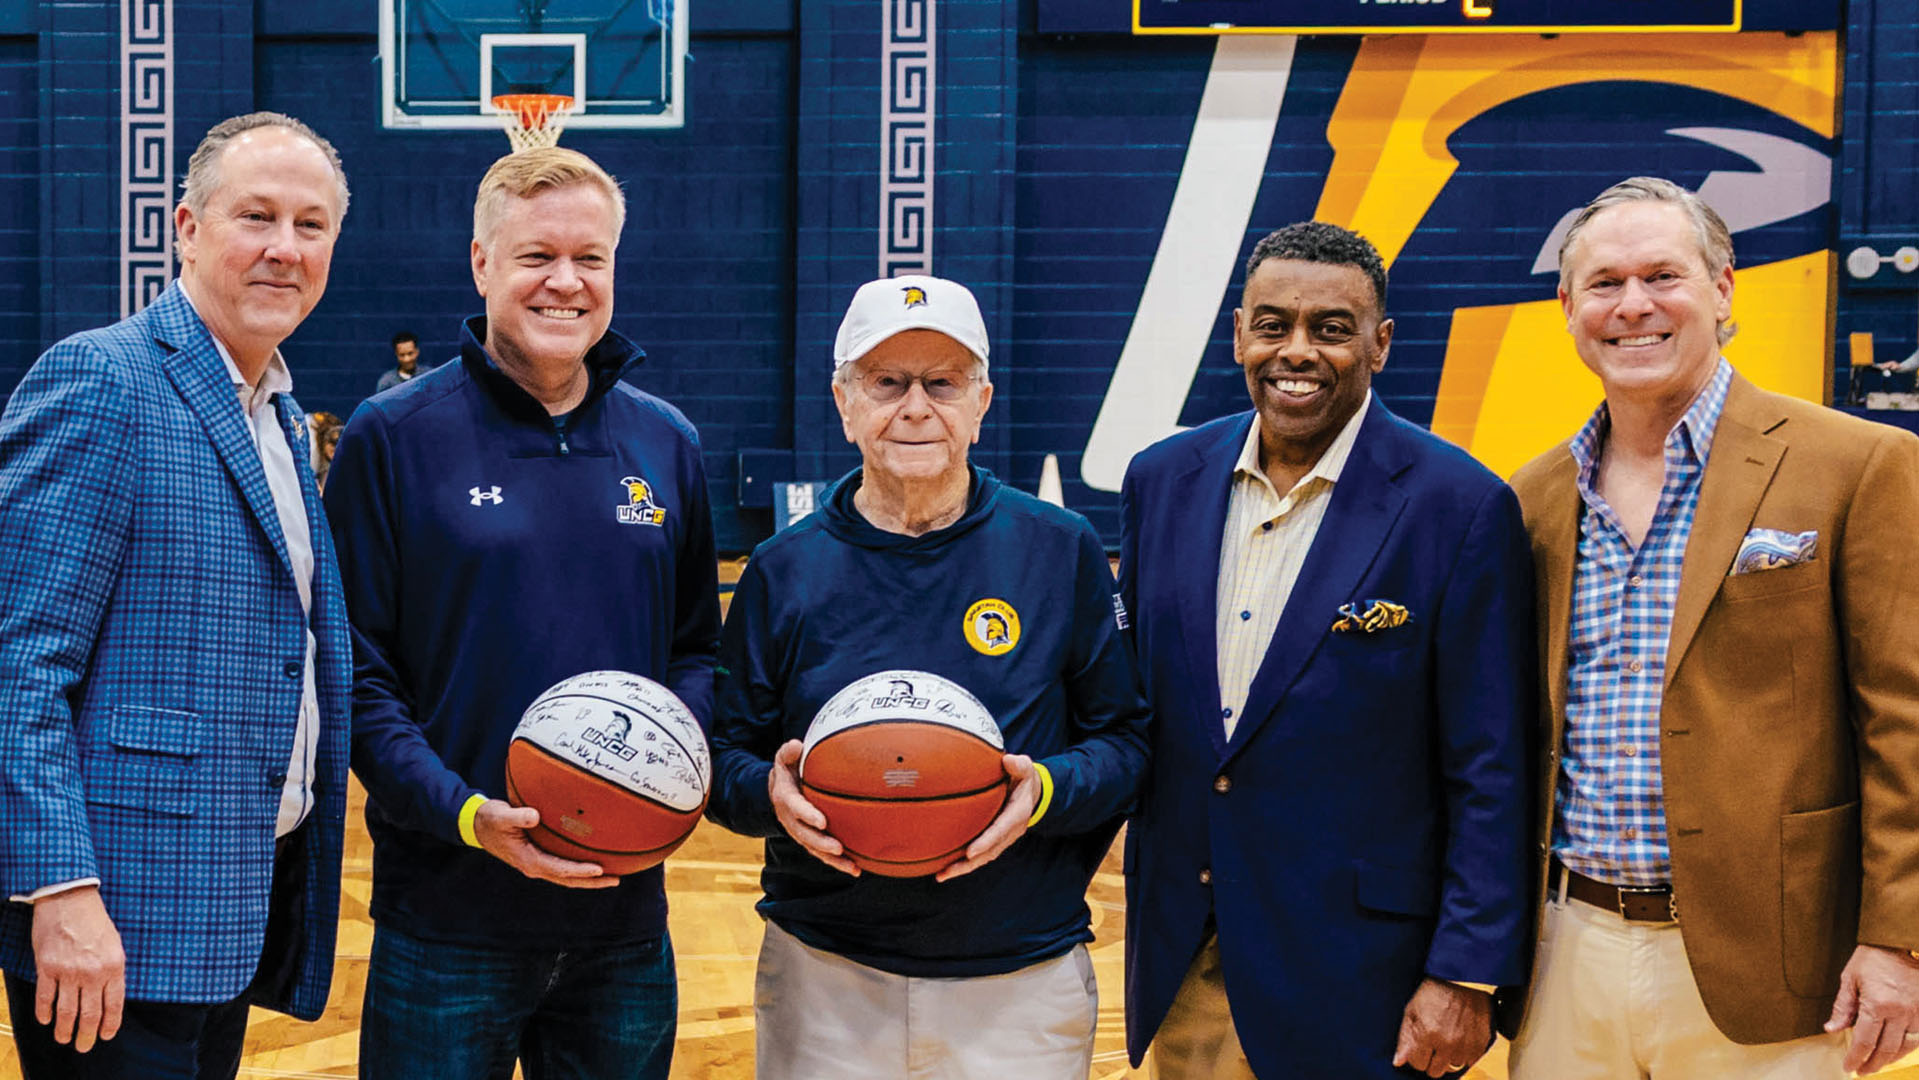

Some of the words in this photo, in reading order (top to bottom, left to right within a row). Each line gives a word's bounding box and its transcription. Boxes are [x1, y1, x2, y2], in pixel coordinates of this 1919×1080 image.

[617, 505, 666, 526] UNCG
[871, 696, 931, 711] UNCG
[581, 727, 638, 762] UNCG
